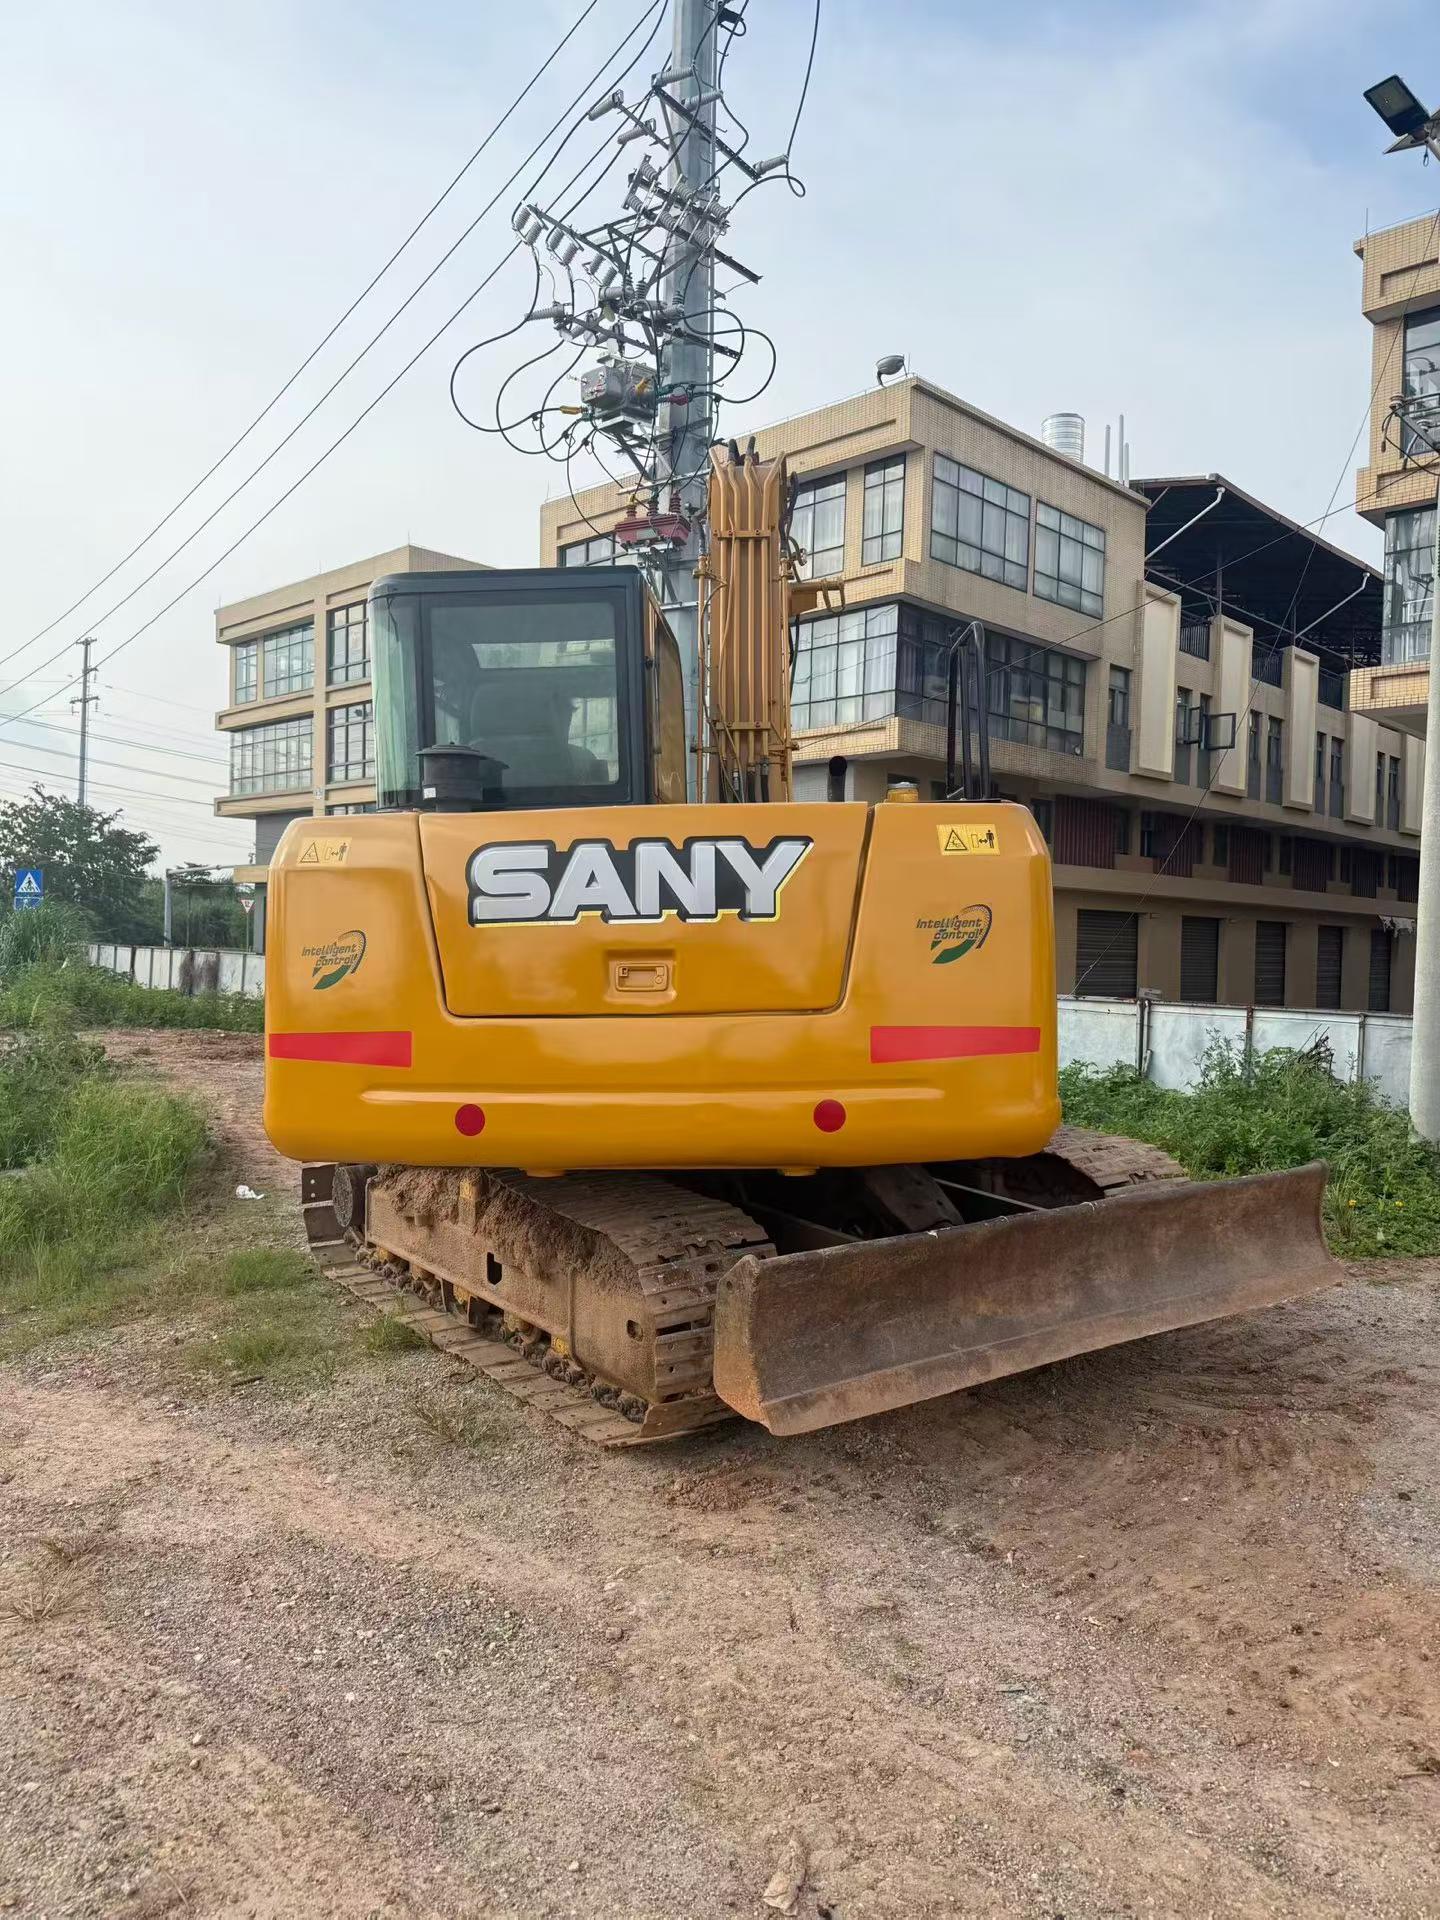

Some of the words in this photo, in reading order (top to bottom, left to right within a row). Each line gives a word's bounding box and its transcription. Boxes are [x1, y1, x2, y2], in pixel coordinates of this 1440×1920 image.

[470, 838, 810, 922] SANY
[915, 917, 982, 930] Intelligent
[301, 943, 357, 957] Intelligent
